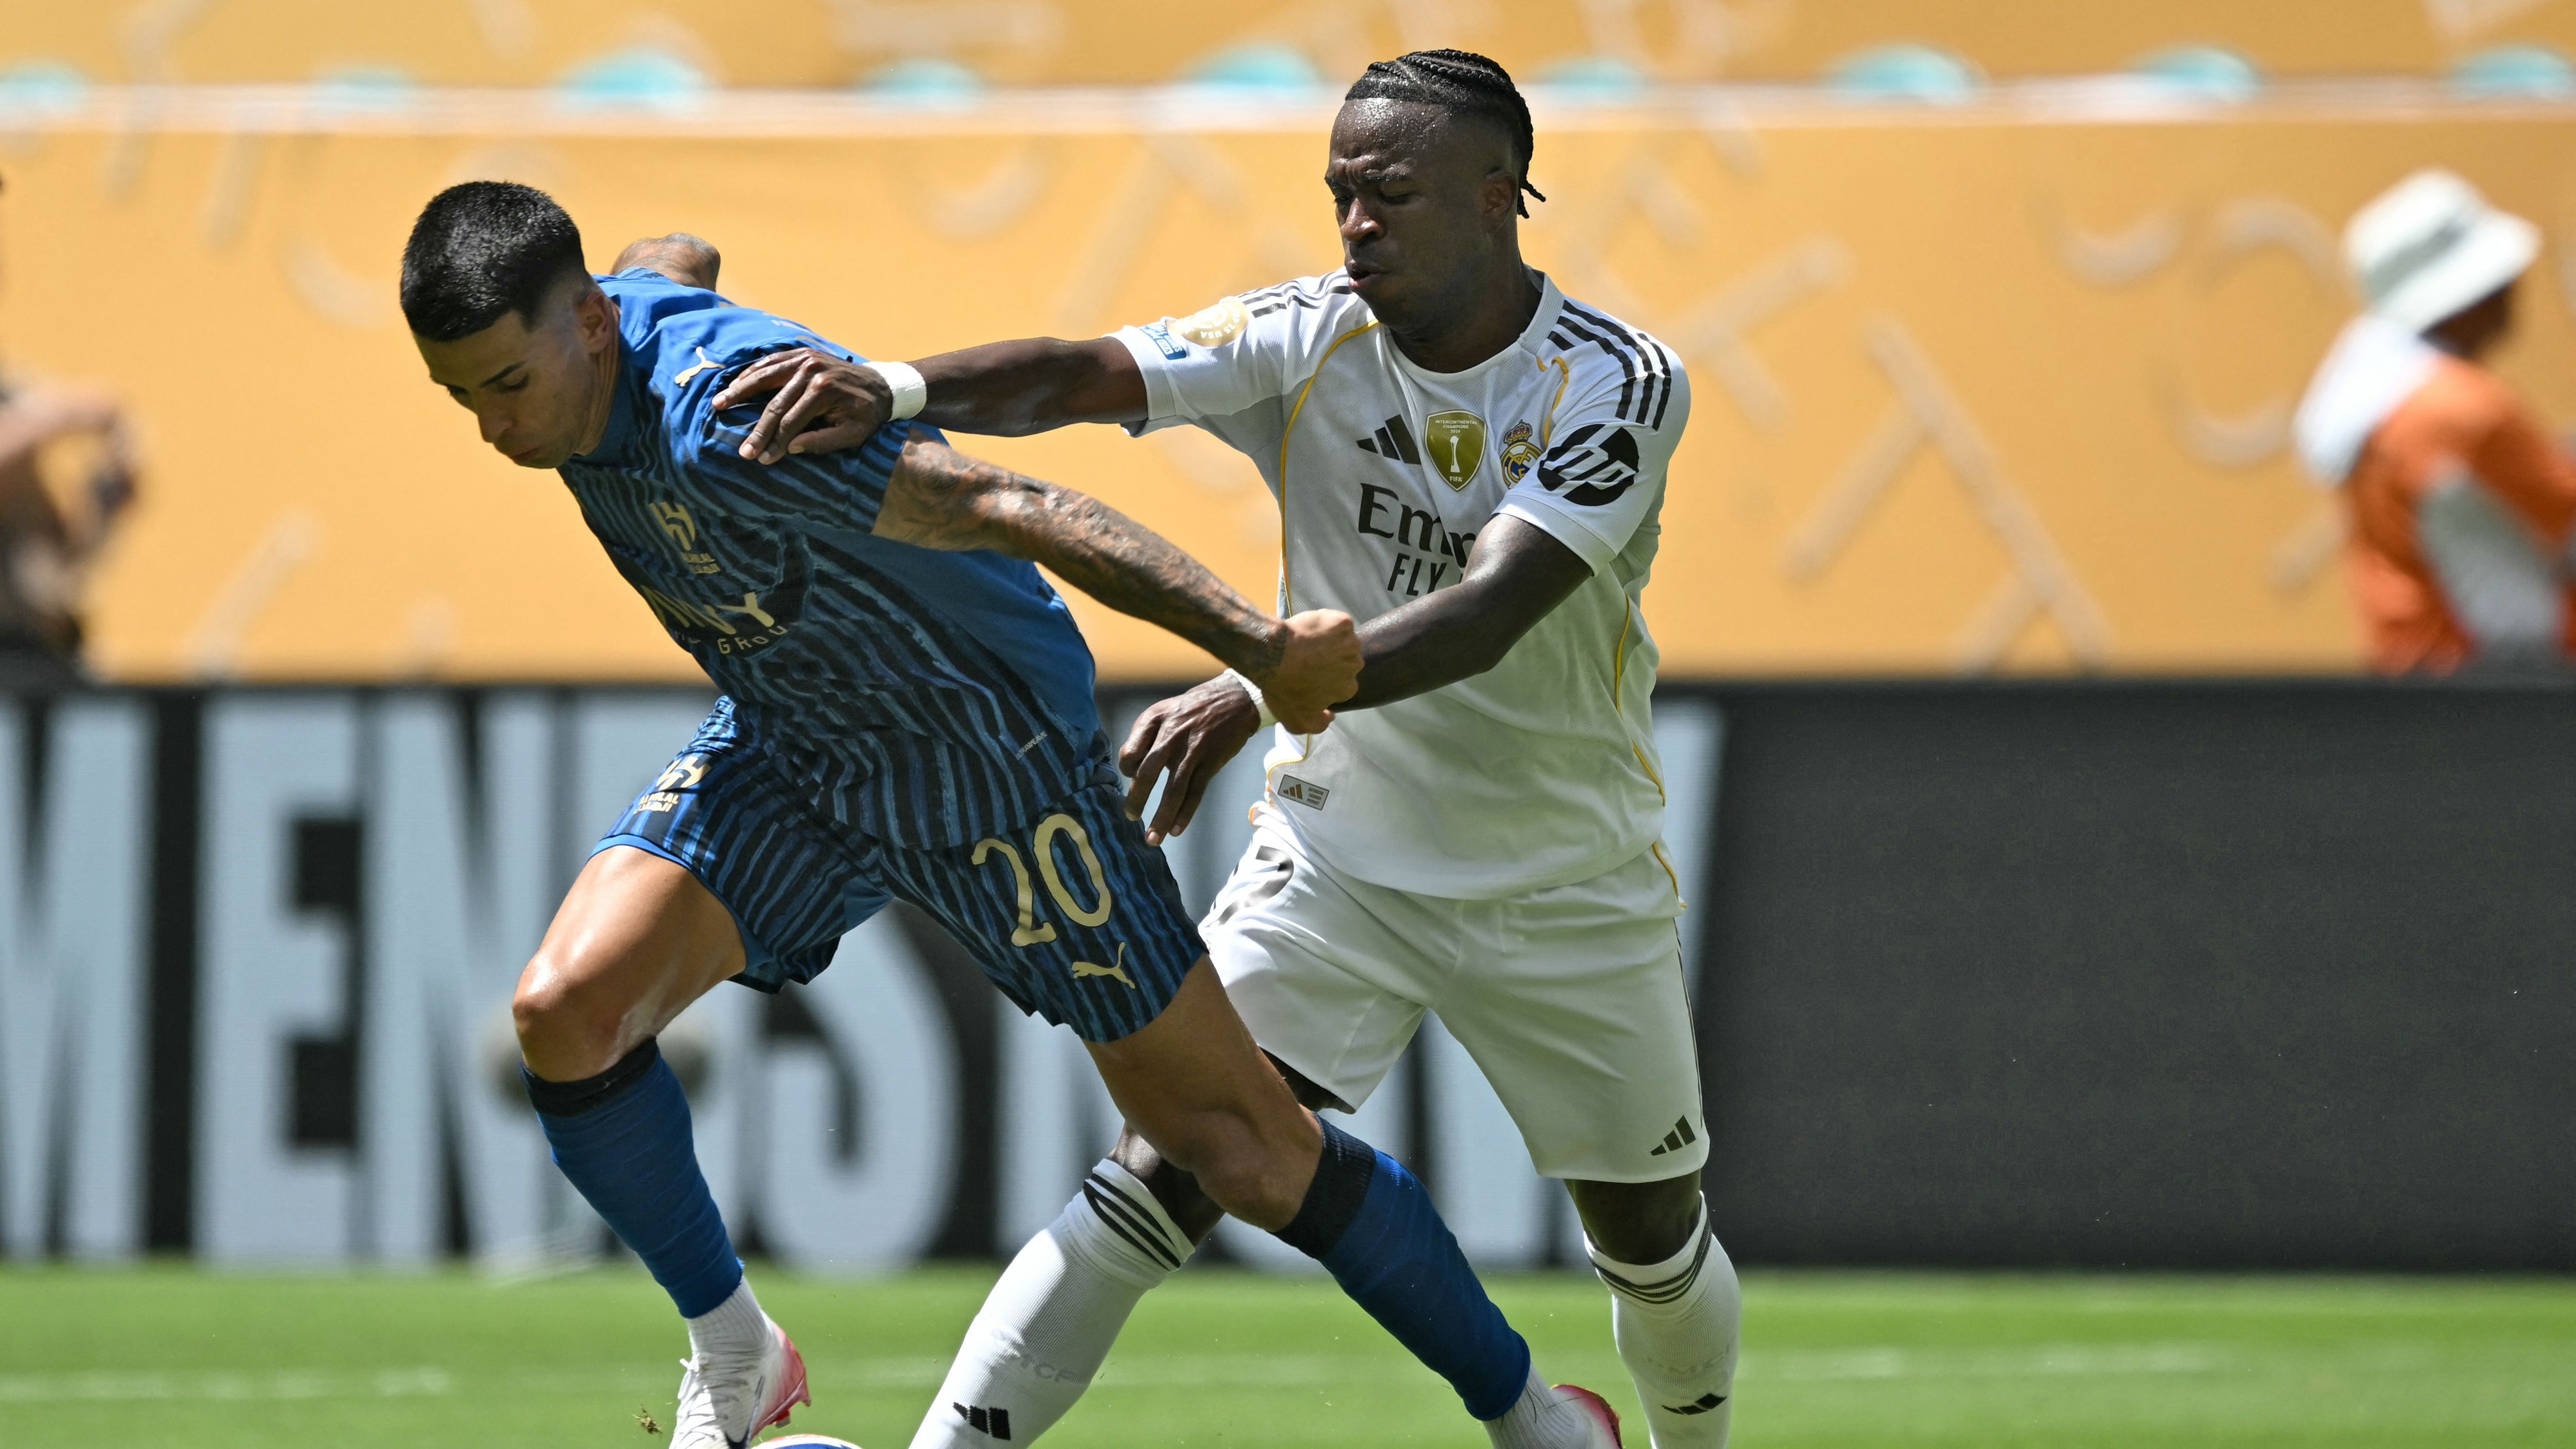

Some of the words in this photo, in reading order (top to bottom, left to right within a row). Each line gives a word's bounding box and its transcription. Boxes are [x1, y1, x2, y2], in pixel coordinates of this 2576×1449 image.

[1200, 330, 1223, 339] USA
[1387, 552, 1447, 596] FLY
[971, 813, 1111, 947] 20
